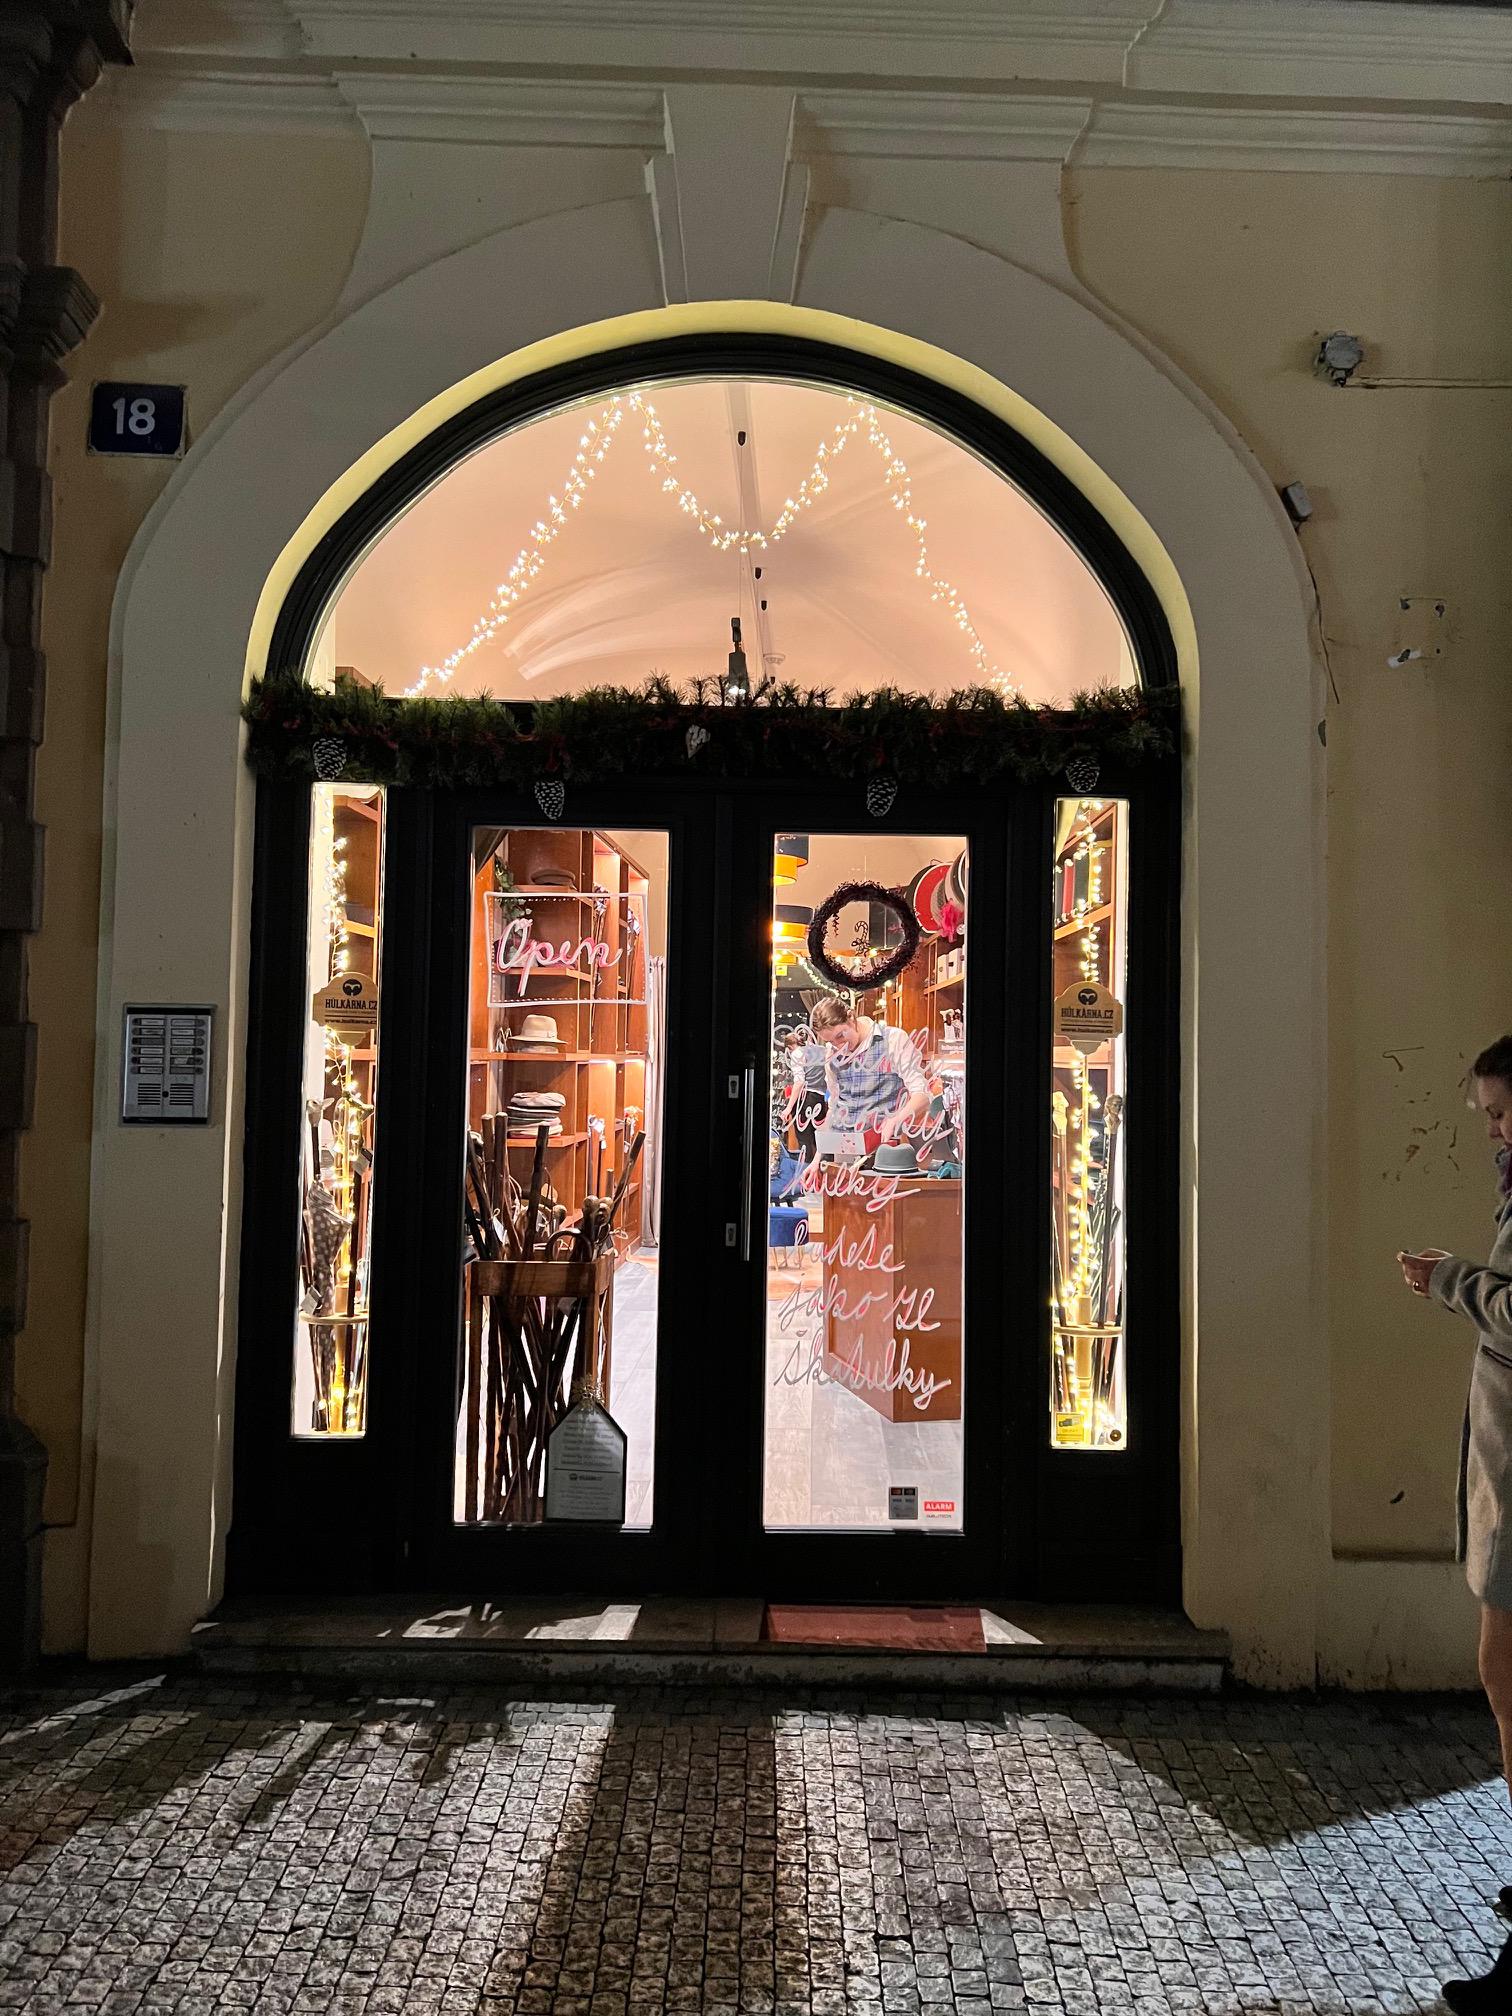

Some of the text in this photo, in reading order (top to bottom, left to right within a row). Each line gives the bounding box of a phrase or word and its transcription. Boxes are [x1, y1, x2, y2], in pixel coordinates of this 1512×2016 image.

[112, 397, 156, 435] 18
[496, 918, 623, 997] Open
[925, 1502, 953, 1510] ALARM
